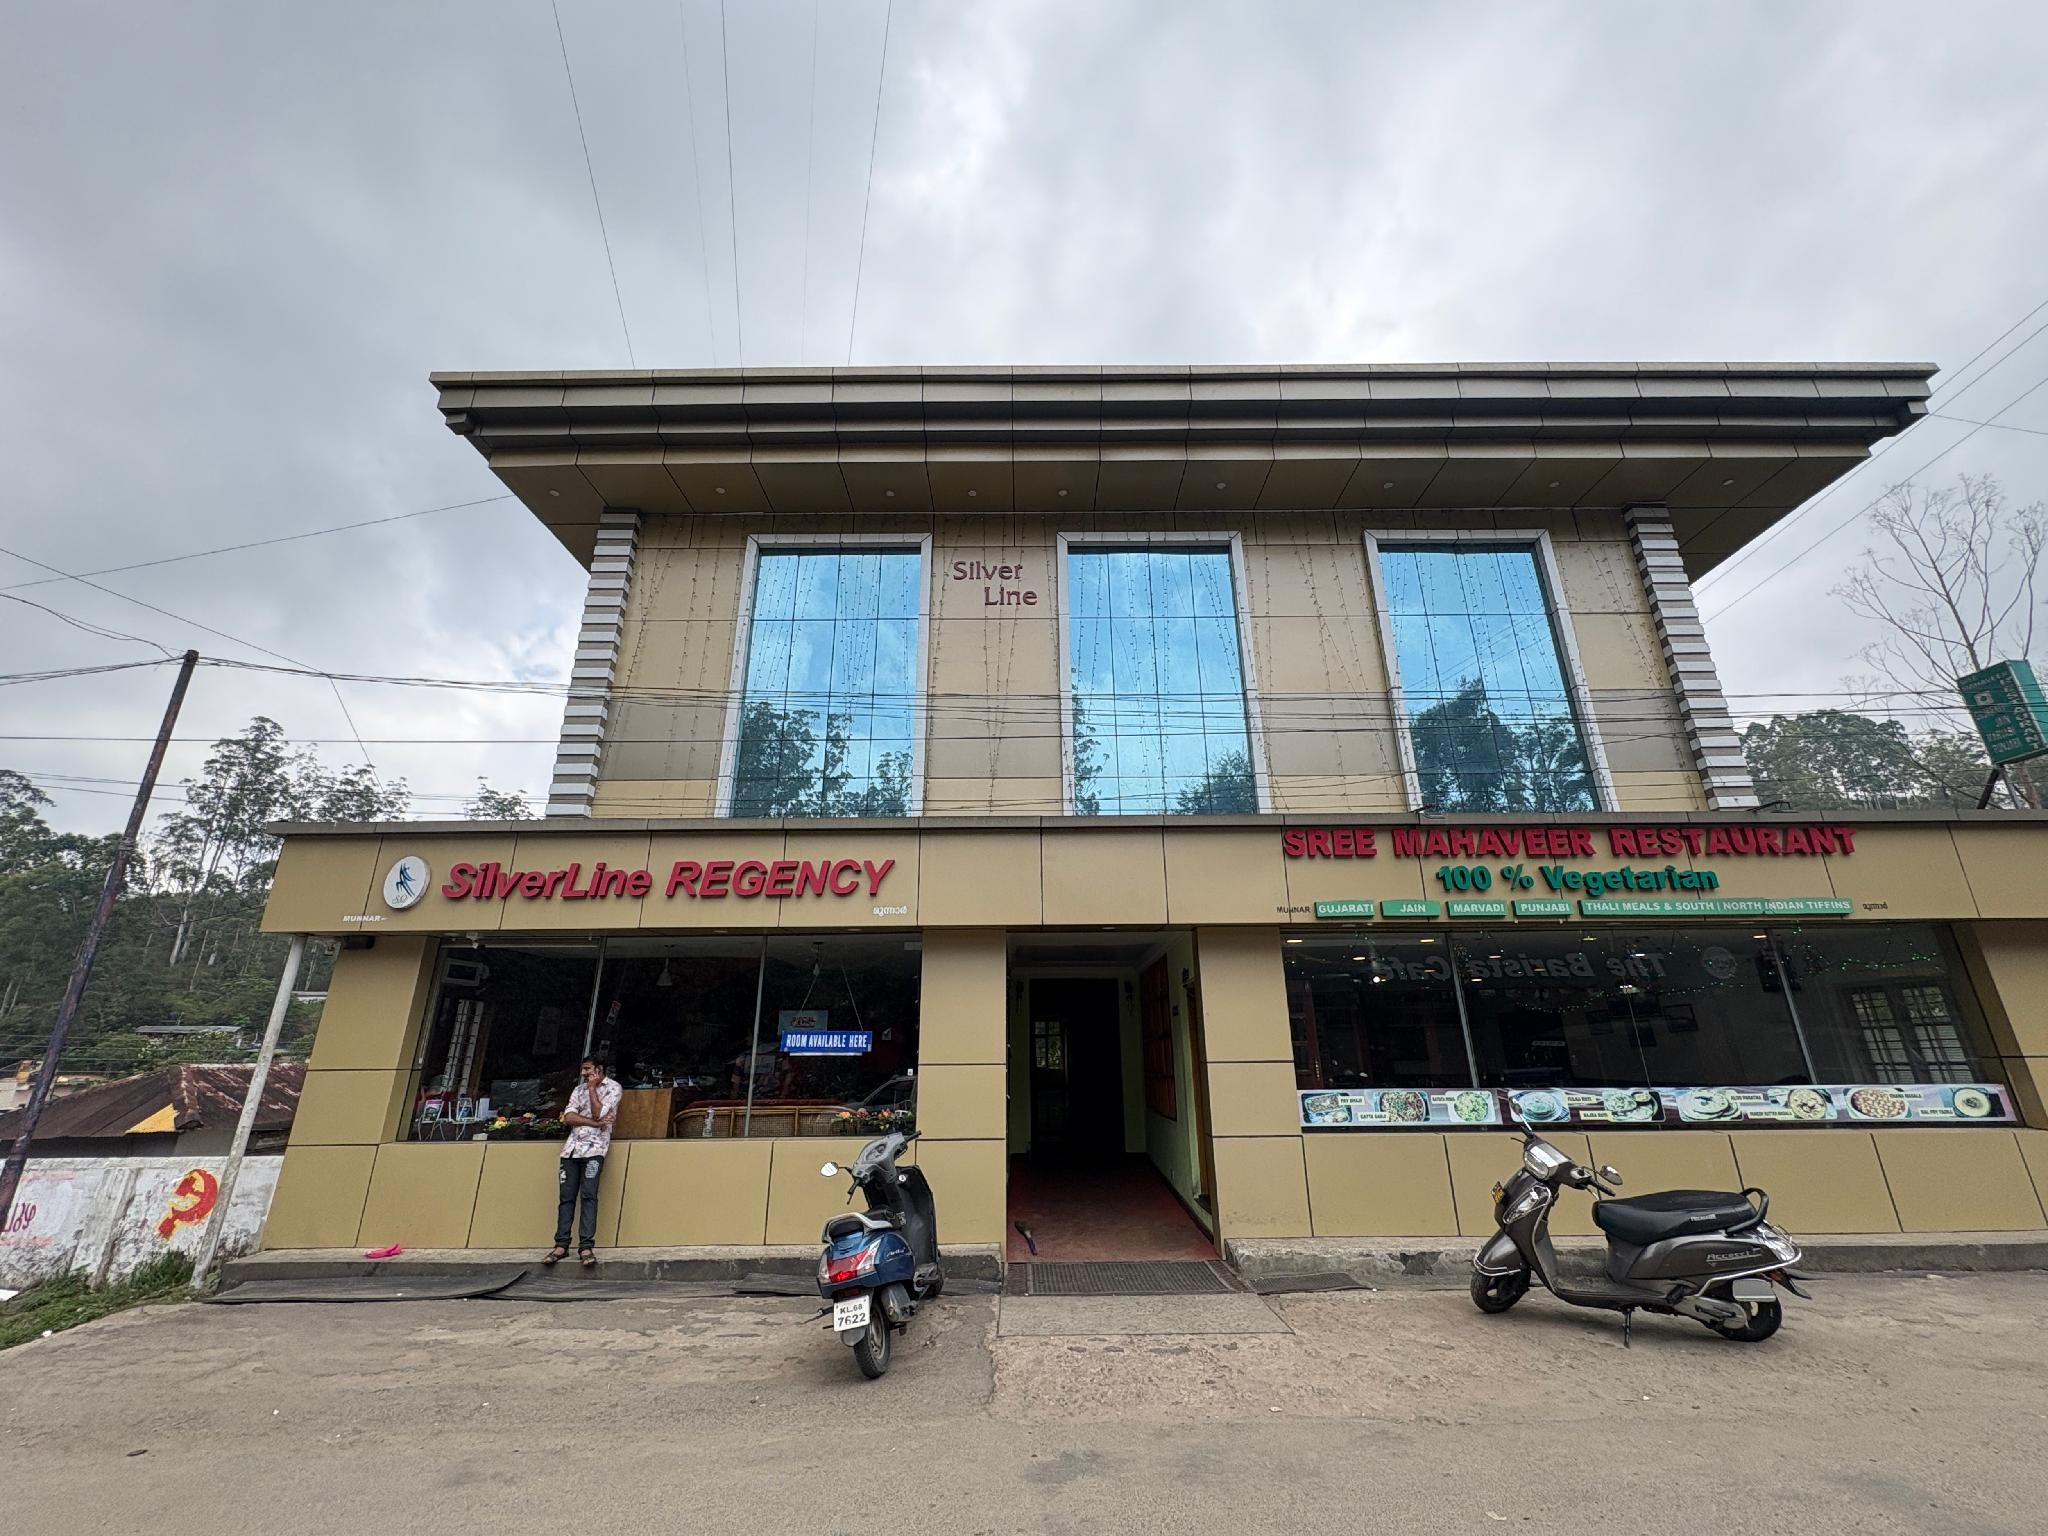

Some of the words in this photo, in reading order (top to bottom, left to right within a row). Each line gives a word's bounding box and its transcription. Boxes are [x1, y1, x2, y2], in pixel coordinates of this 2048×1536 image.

[953, 560, 1023, 581] Silver
[984, 586, 1038, 606] Line
[1283, 828, 1377, 858] SREE
[1391, 827, 1597, 858] MAHAVEER
[1608, 826, 1857, 857] RESTAURANT
[441, 861, 653, 900] SilverLine
[664, 859, 896, 898] REGENCY
[1436, 865, 1492, 892] 100
[1500, 864, 1535, 891] %
[1538, 864, 1720, 897] Vegetarian
[1318, 903, 1375, 914] GUJARATI
[1400, 903, 1426, 913] JAIN
[1453, 903, 1505, 913] MARVADI
[1520, 903, 1570, 912] PUNJABI
[1585, 902, 1620, 911] THALI
[1622, 902, 1661, 911] MEALS
[1675, 901, 1714, 911] SOUTH
[1723, 901, 1762, 911] NORTH
[1764, 901, 1804, 911] INDIAN
[1806, 900, 1850, 910] TIFFINS
[786, 1034, 807, 1048] ROOM
[808, 1034, 846, 1048] AVAILABLE
[848, 1034, 868, 1048] HERE
[838, 1312, 866, 1327] 7622
